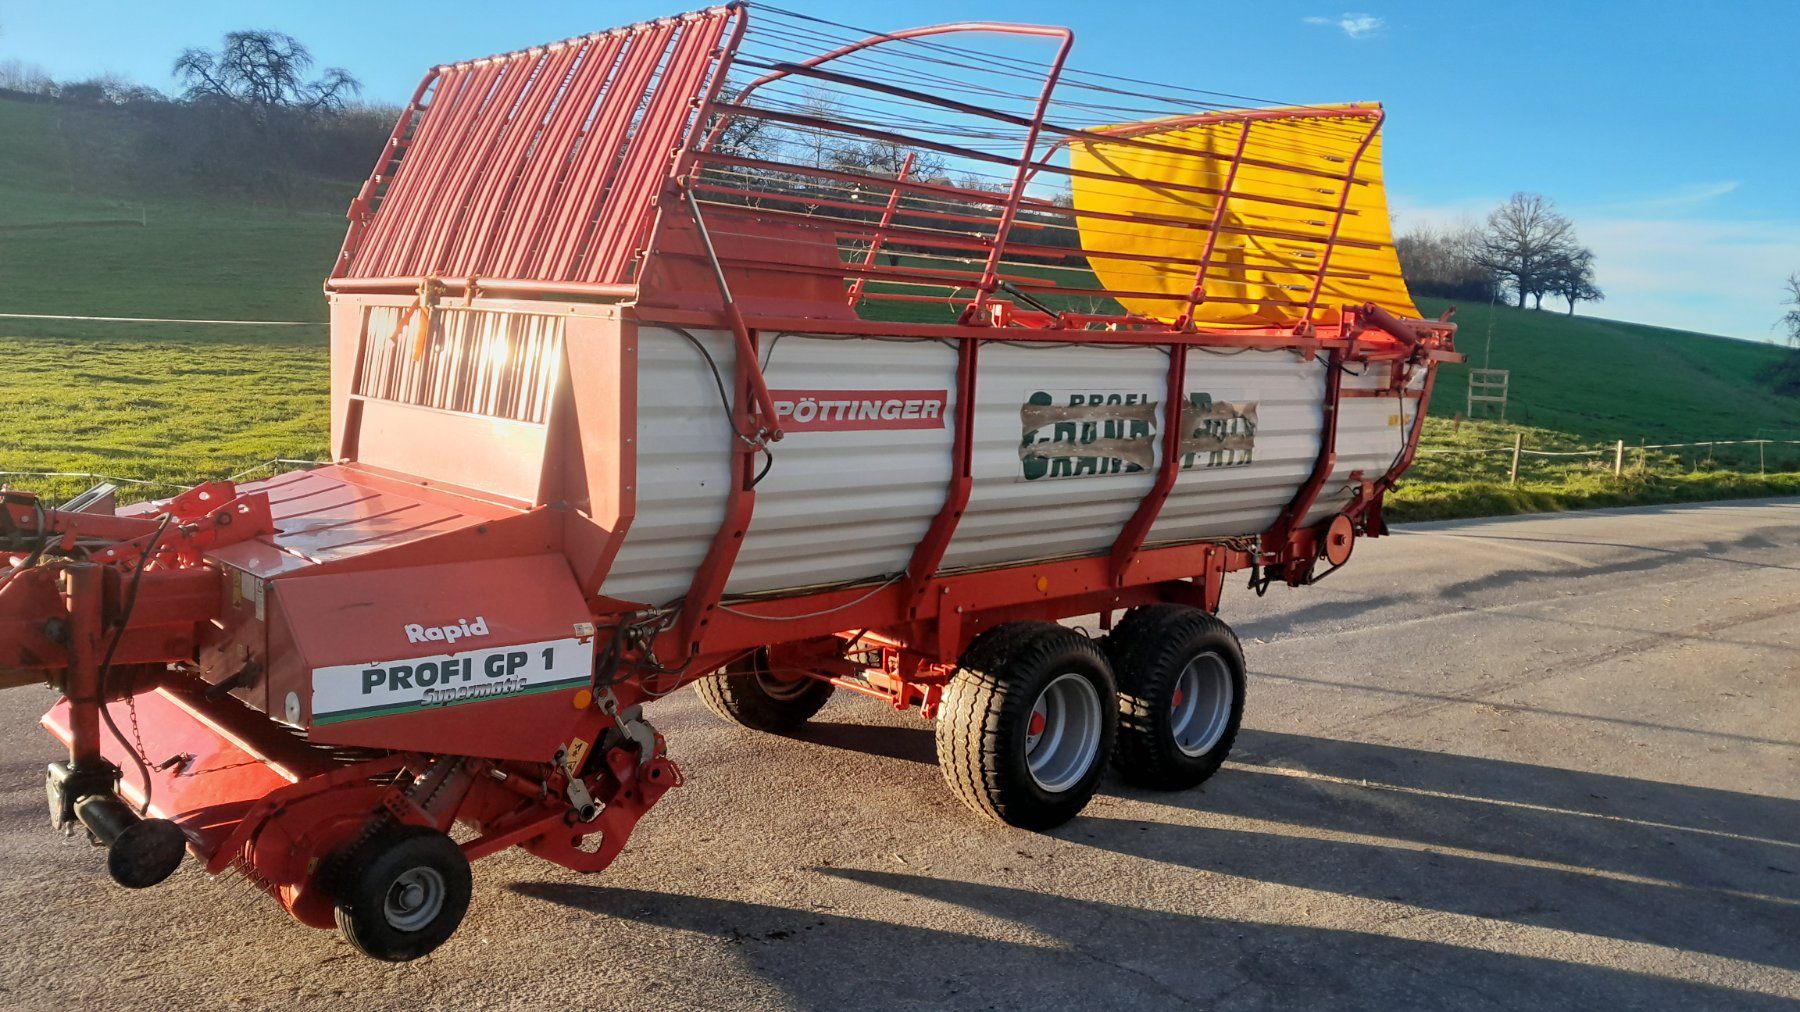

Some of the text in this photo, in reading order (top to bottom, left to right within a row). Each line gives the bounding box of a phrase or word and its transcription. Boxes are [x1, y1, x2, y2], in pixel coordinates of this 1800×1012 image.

[773, 397, 942, 423] PÖTTINGER
[404, 616, 490, 644] Rapid
[361, 647, 555, 695] PROFI GP 1
[420, 674, 528, 707] Supermatic
